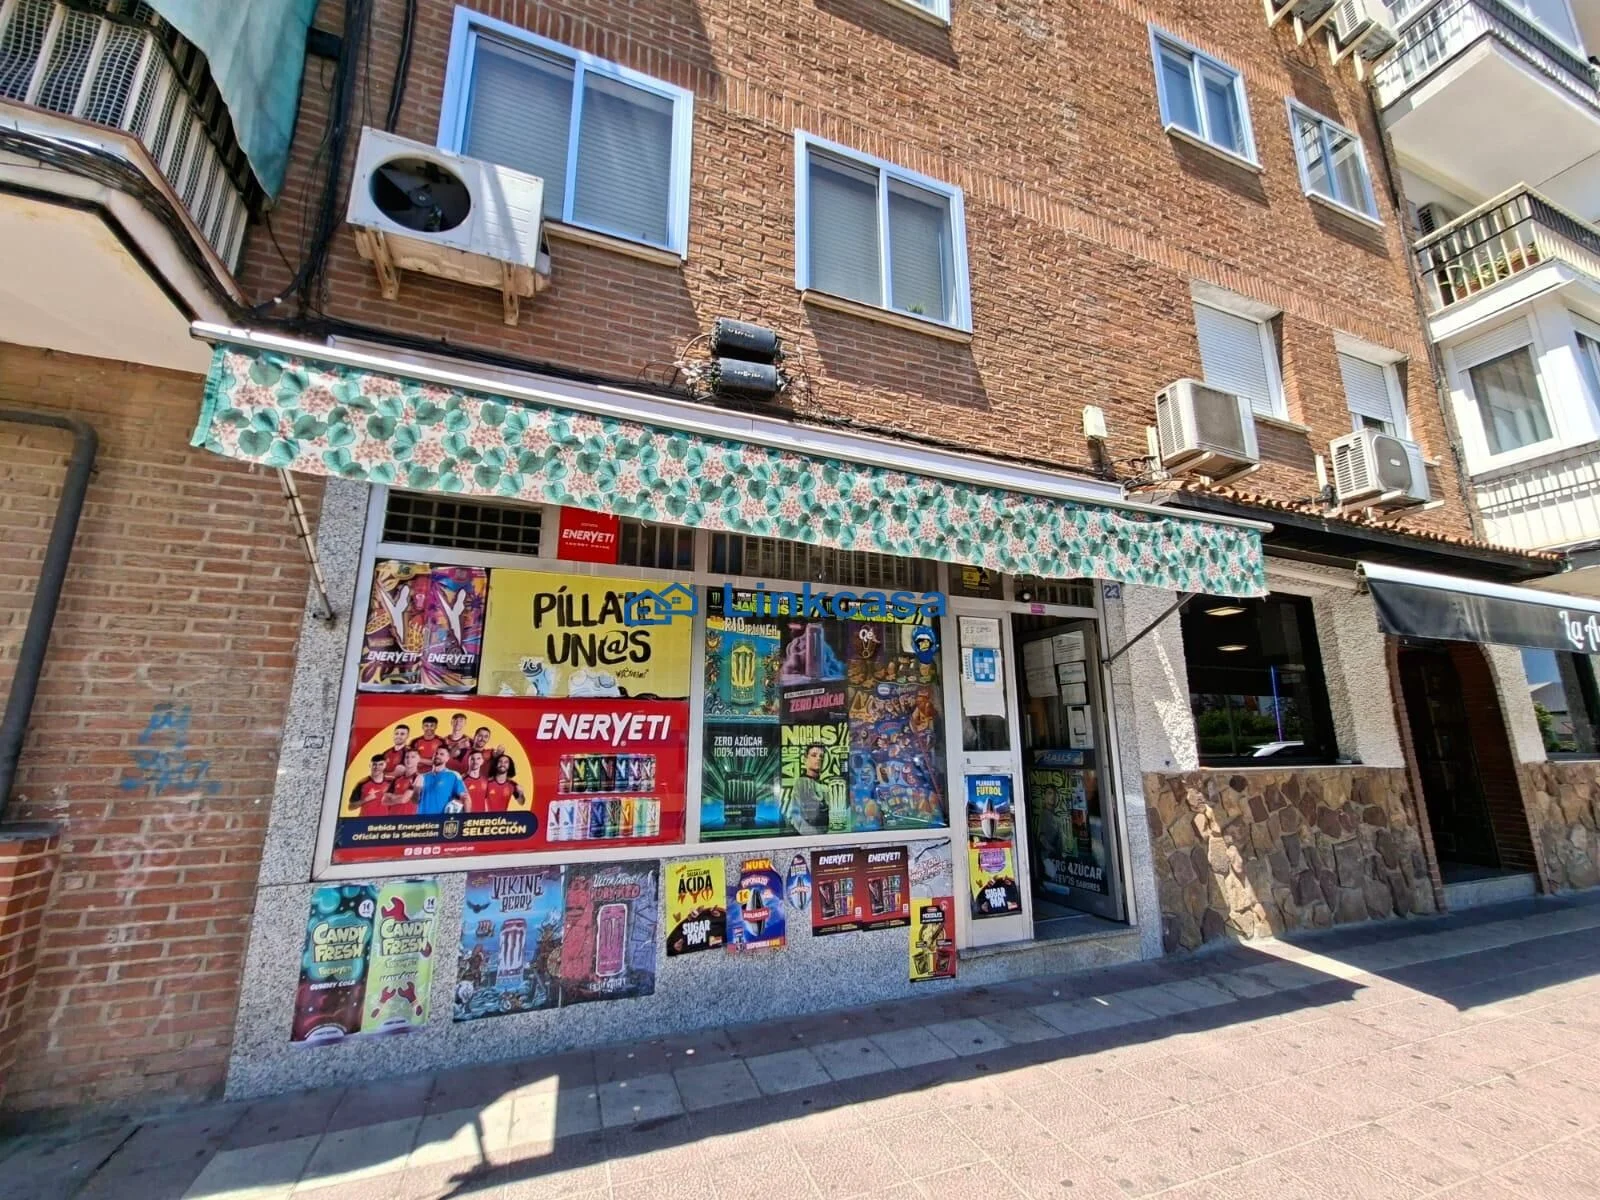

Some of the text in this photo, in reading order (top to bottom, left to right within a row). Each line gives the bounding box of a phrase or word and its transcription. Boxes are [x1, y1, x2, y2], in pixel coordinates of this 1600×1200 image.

[562, 529, 614, 543] ENERYETI
[1104, 584, 1121, 599] 23
[1559, 611, 1600, 651] La A
[367, 650, 417, 663] ENERYETI
[547, 630, 652, 668] UN@S
[427, 653, 475, 665] ENERYETI
[789, 697, 812, 713] ZERO
[536, 712, 671, 747] ENERYETI
[714, 734, 763, 746] ZERO AZÚCAR
[714, 747, 768, 757] 100% MONSTER
[398, 823, 440, 832] Energética
[467, 817, 507, 827] ENERGÍA
[352, 833, 379, 841] Oficial
[402, 831, 439, 839] Selección
[462, 824, 527, 837] SELECCIÓN
[819, 853, 854, 866] ENERYETI
[868, 851, 901, 864] ENERYETI
[491, 874, 545, 900] VIKING
[678, 873, 713, 894] ÁCIDA
[984, 887, 1007, 900] SUGAR
[500, 894, 532, 913] BERRY
[313, 922, 367, 945] CANDY
[380, 918, 432, 938] CANDY
[682, 919, 710, 936] SUGAR
[686, 930, 706, 945] PAPI
[314, 942, 364, 963] FRESH
[381, 937, 428, 956] FRESH
